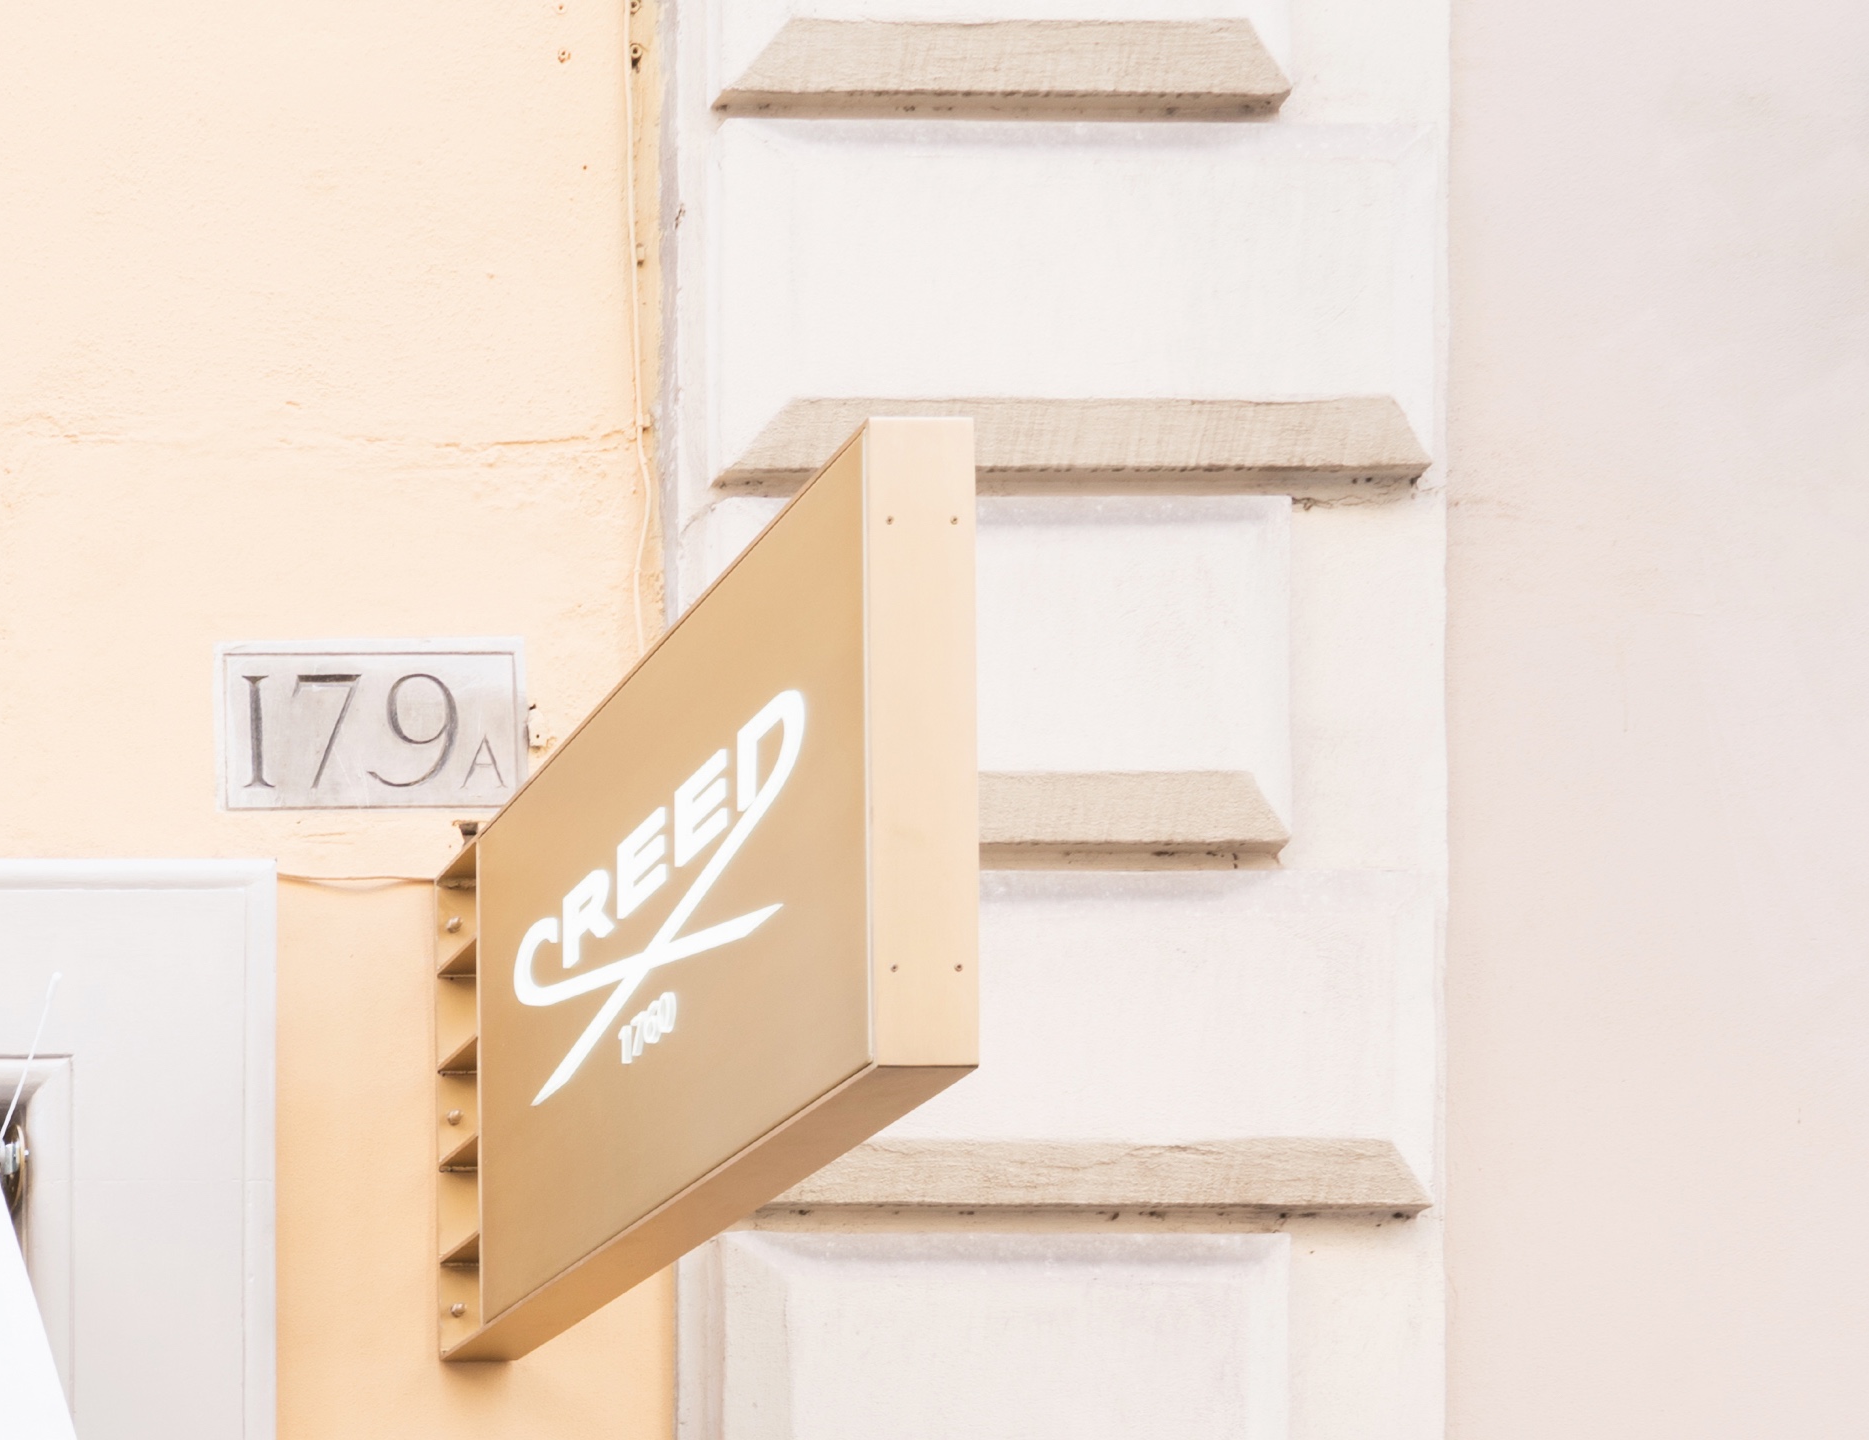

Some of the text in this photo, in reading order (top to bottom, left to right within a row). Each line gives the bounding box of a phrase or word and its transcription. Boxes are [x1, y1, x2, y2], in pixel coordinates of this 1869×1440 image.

[241, 673, 509, 789] 179A
[513, 689, 806, 1008] CREED
[617, 991, 679, 1066] 1760
